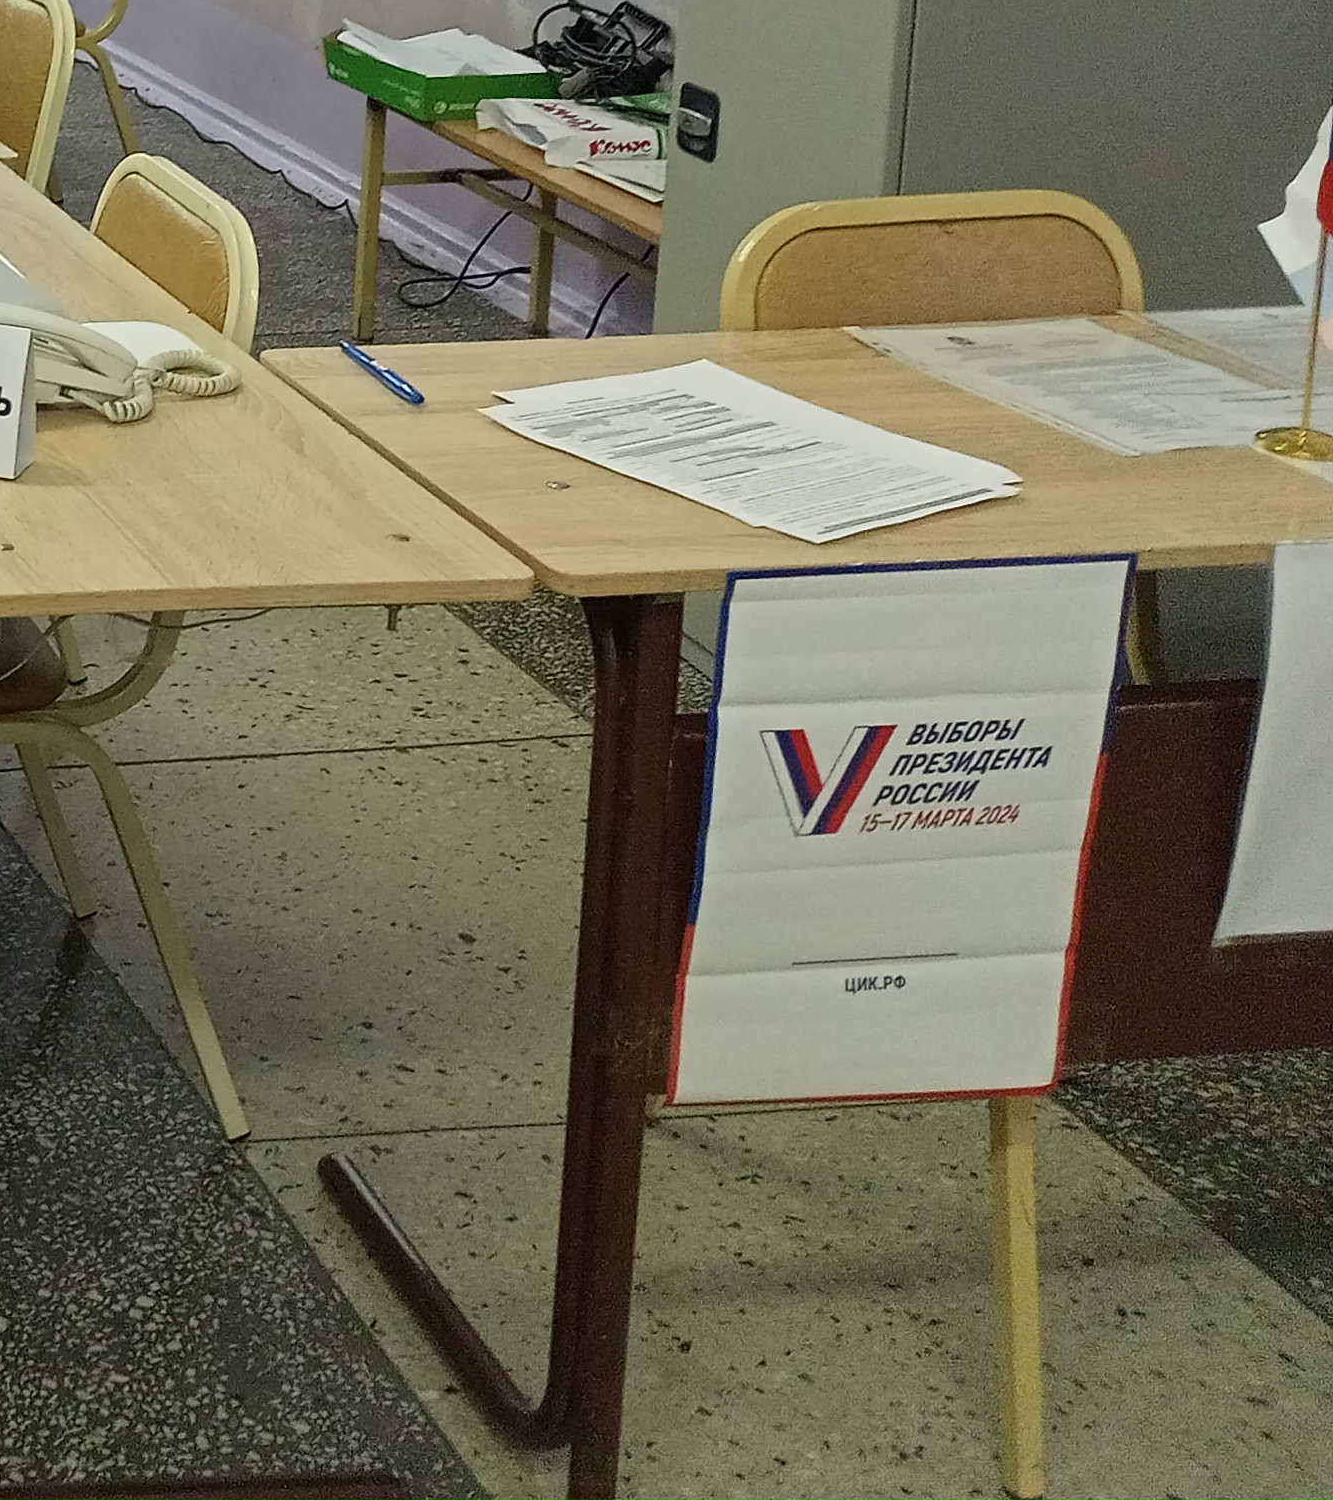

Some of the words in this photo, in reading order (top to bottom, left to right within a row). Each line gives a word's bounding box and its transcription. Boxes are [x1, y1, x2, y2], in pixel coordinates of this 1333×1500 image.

[906, 719, 1025, 746] ВЫБОРЫ
[889, 746, 1053, 776] ПРЕЗИДЕНТА
[873, 779, 981, 806] РОССИИ
[911, 807, 975, 831] МАРТА
[975, 804, 1021, 826] 2024
[844, 975, 907, 995] ЦИК.РФ
